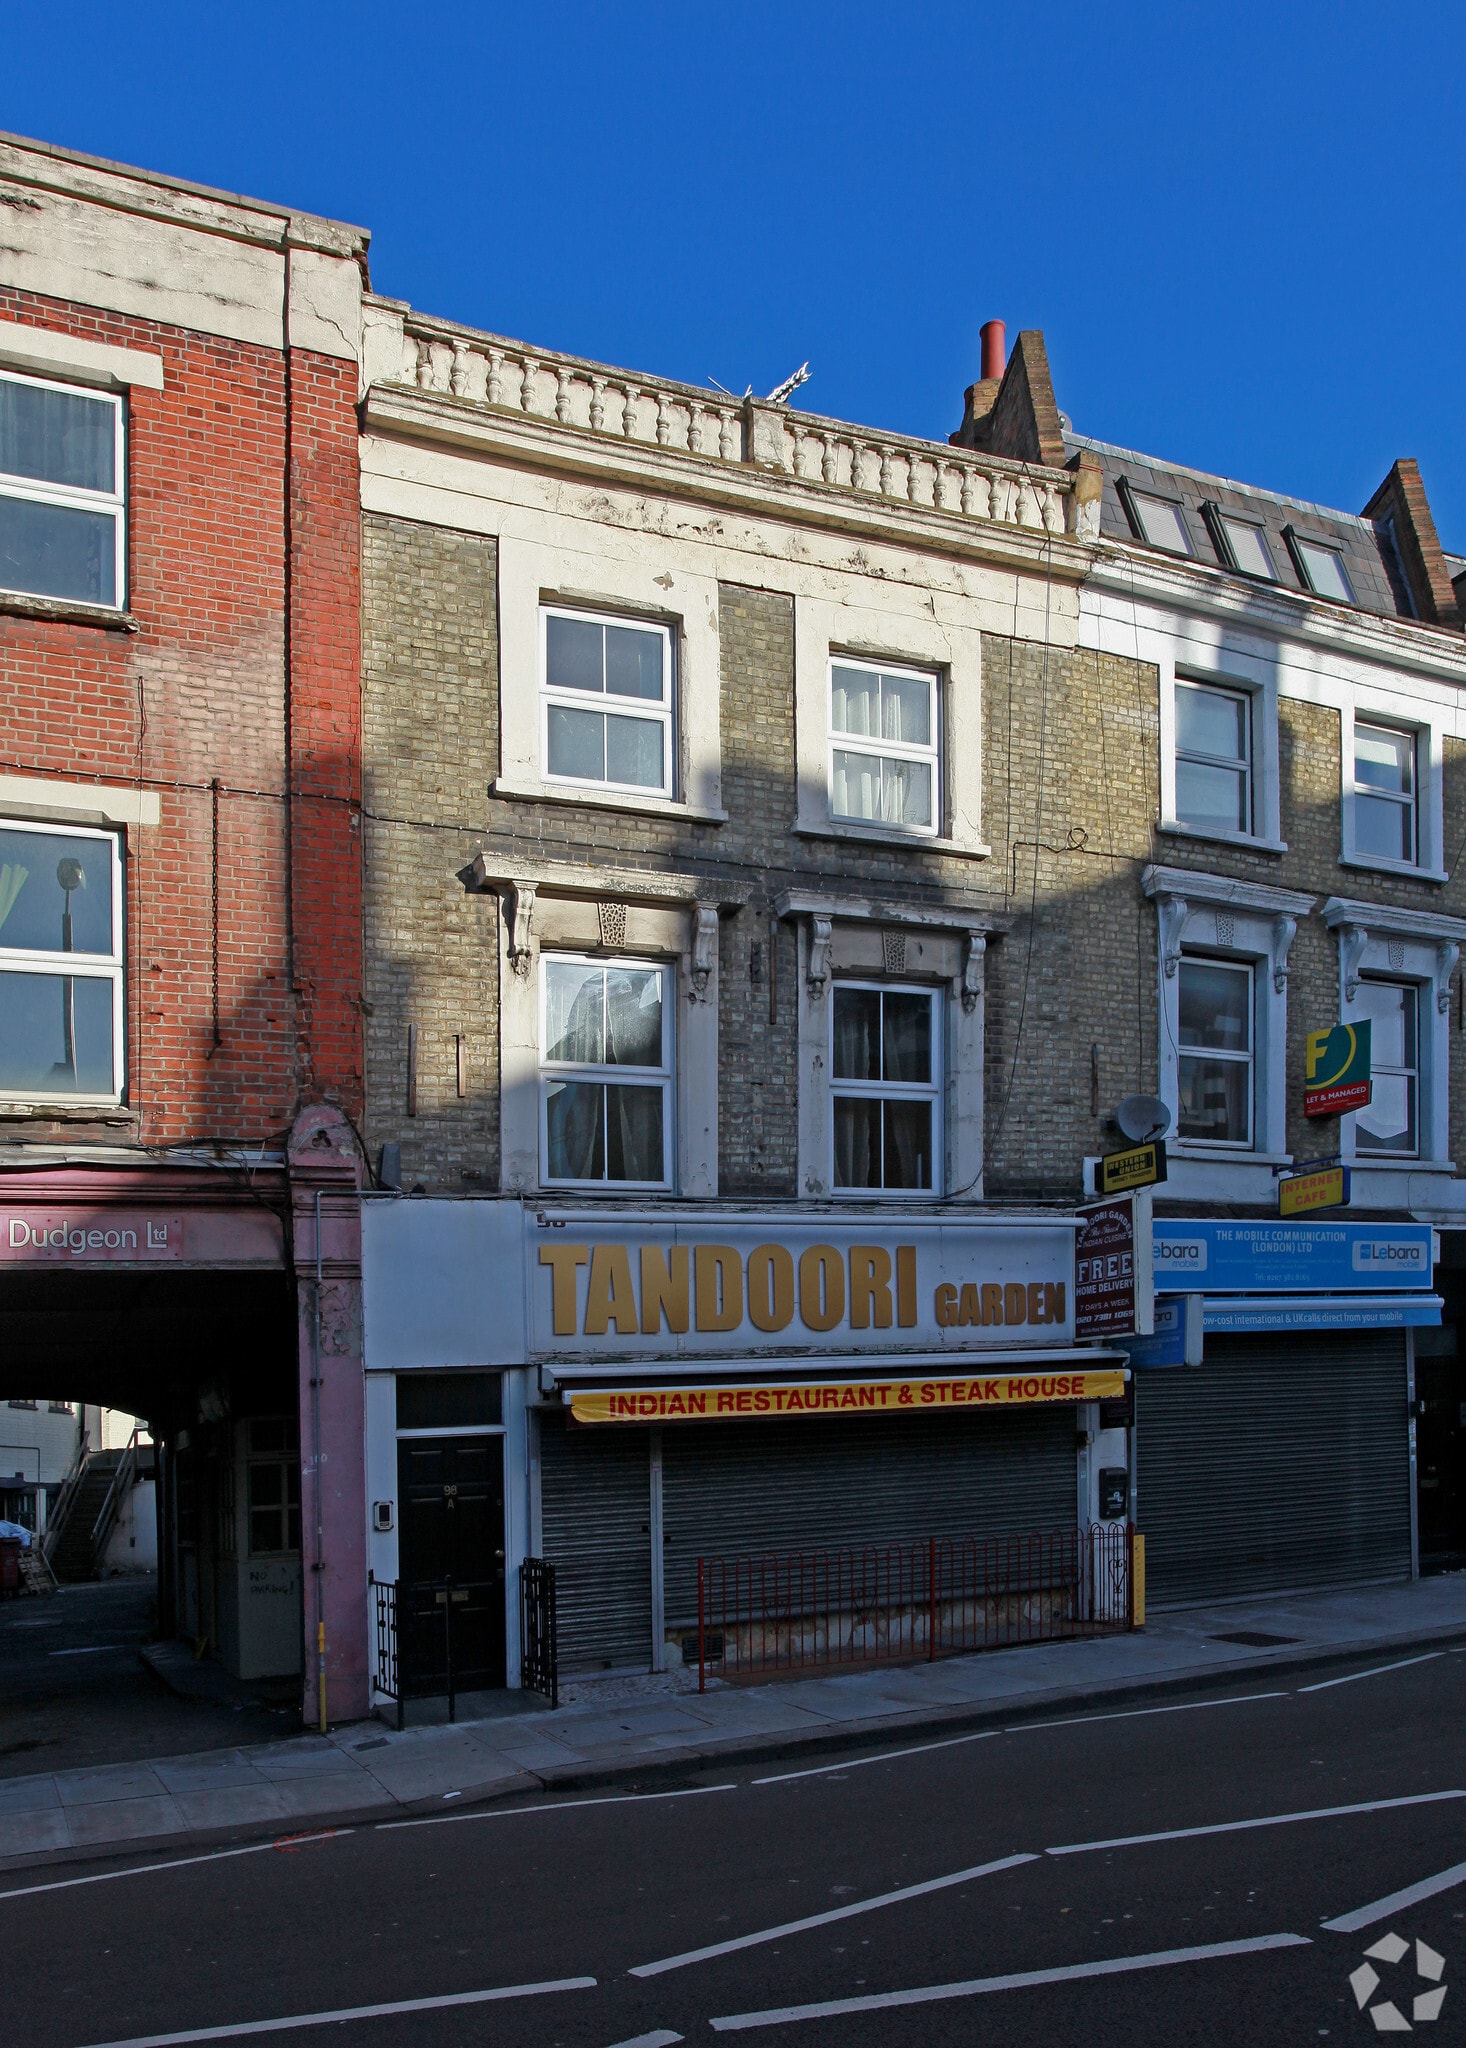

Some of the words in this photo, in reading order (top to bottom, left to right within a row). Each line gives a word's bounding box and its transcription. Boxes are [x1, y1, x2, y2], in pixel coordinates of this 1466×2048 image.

[1306, 1095, 1319, 1104] LET
[1320, 1094, 1327, 1102] &
[1328, 1086, 1367, 1100] MANAGED
[1107, 1154, 1146, 1170] WESTERN
[1119, 1162, 1146, 1175] UNION
[1112, 1175, 1128, 1184] MONEY
[1129, 1169, 1152, 1179] TRANSFER
[1281, 1171, 1341, 1195] INTERNET
[1295, 1190, 1326, 1206] CAFE
[8, 1219, 138, 1254] Dudgeon
[147, 1221, 168, 1249] Ltd
[1076, 1211, 1107, 1249] TANDOORI
[1109, 1210, 1133, 1239] GARDEN
[1216, 1230, 1233, 1241] THE
[1235, 1230, 1270, 1241] MOBILE
[1271, 1231, 1346, 1242] COMMUNICATION
[1083, 1237, 1104, 1248] INDIAN
[1104, 1232, 1128, 1244] CUISINE
[1252, 1242, 1295, 1254] (LONDON)
[1297, 1243, 1313, 1253] LTD
[1152, 1242, 1199, 1260] ebara
[1372, 1244, 1420, 1260] Lebara
[1078, 1252, 1132, 1283] FREE
[1172, 1260, 1199, 1268] mobile
[540, 1243, 918, 1336] TANDOORI
[935, 1281, 1067, 1327] GARDEN
[1076, 1285, 1097, 1297] HOME
[1098, 1278, 1134, 1293] DELIVERY
[1080, 1304, 1085, 1312] 7
[1085, 1302, 1102, 1311] DAYS
[1110, 1298, 1130, 1307] WEEK
[1076, 1316, 1092, 1324] 020
[1203, 1315, 1234, 1326] ow-cost
[1235, 1313, 1284, 1325] international
[1285, 1314, 1292, 1323] &
[1322, 1312, 1343, 1322] direct
[1344, 1312, 1361, 1322] from
[1361, 1313, 1379, 1324] your
[1379, 1311, 1403, 1321] mobile
[609, 1393, 706, 1417] INDIAN
[717, 1385, 891, 1412] RESTAURANT
[897, 1384, 914, 1404] &
[920, 1380, 1001, 1403] STEAK
[1008, 1376, 1085, 1398] HOUSE
[443, 1484, 458, 1496] 98
[447, 1498, 455, 1510] A
[250, 1571, 267, 1581] NO
